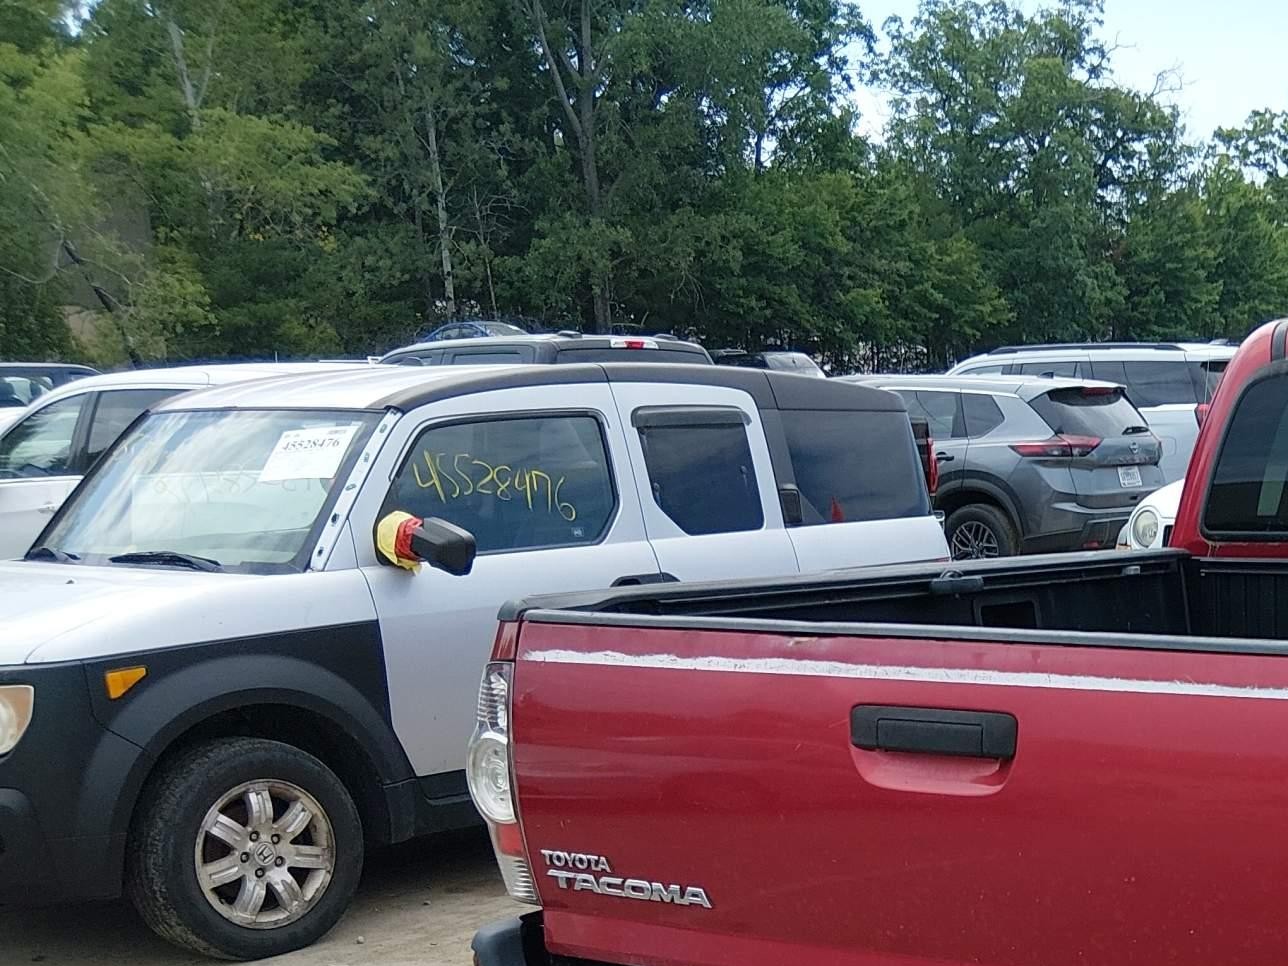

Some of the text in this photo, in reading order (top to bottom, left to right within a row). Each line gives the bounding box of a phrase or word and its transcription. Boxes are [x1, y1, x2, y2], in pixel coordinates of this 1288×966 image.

[413, 450, 576, 521] 45528476
[540, 849, 612, 873] TOYOTA
[546, 869, 713, 909] TACOMA
